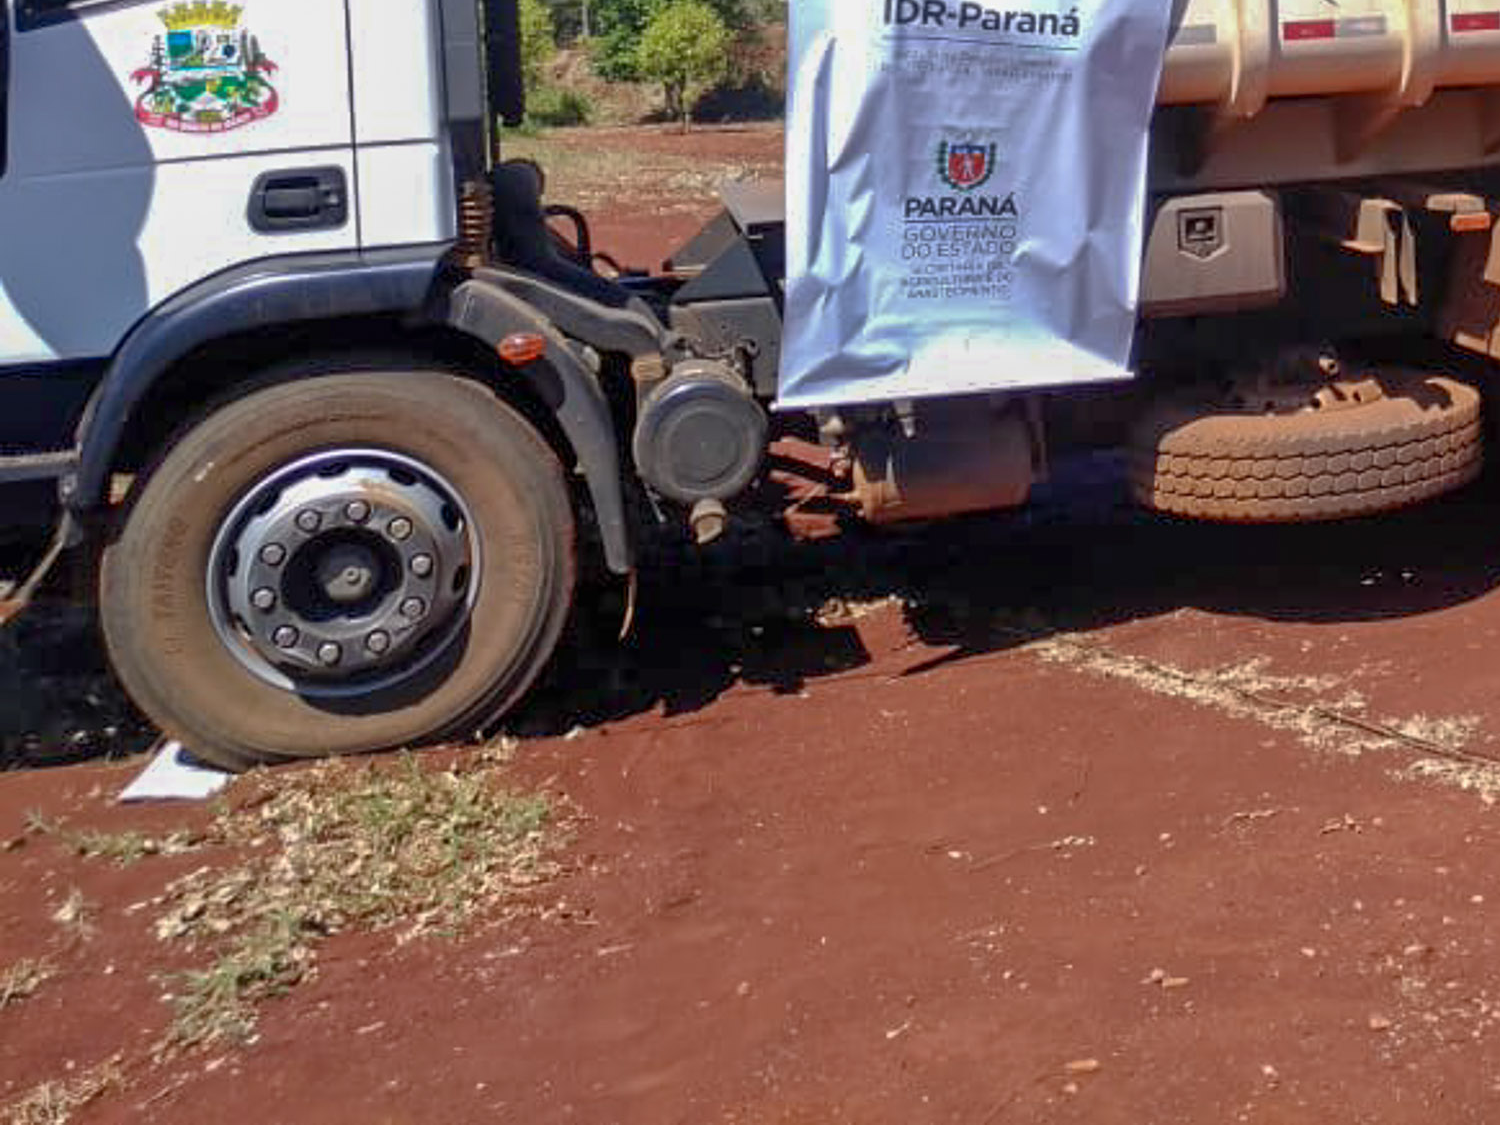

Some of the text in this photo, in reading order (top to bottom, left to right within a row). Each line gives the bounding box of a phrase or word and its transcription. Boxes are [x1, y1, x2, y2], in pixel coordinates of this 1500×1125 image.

[904, 192, 1017, 217] PARANÁ
[904, 225, 1016, 241] GOVERNO
[902, 240, 1015, 259] DO ESTADO
